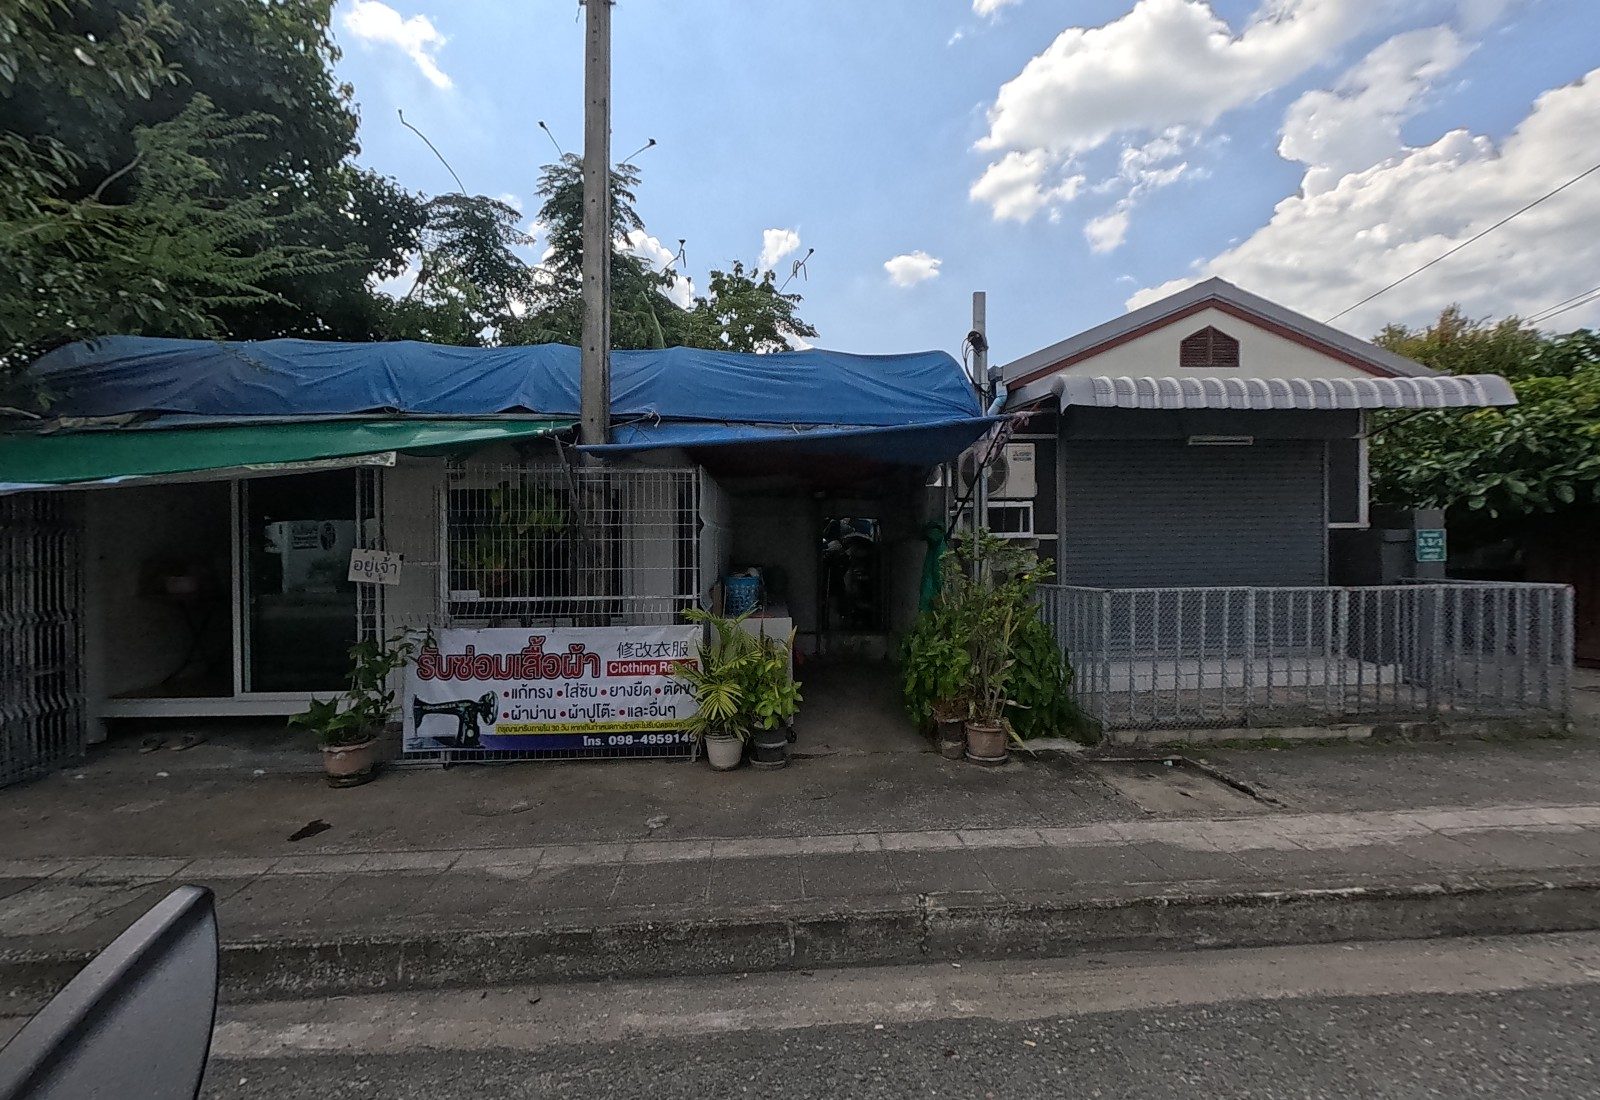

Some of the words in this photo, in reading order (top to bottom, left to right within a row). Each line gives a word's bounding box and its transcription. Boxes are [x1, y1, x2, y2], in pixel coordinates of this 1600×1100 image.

[417, 635, 601, 680] รับซ่อมเสื้อผ้า
[616, 641, 689, 659] 修改衣服
[609, 661, 657, 675] Clothing
[511, 683, 553, 699] แก้ทรง
[565, 682, 598, 698] ใส่ซิบ
[609, 680, 652, 697] ยางยืด
[511, 705, 557, 720] ผ้าม่าน
[568, 702, 616, 723] ผ้าปูโต๊ะ
[627, 698, 676, 718] และอื่นๆ
[583, 735, 605, 747] โทร.
